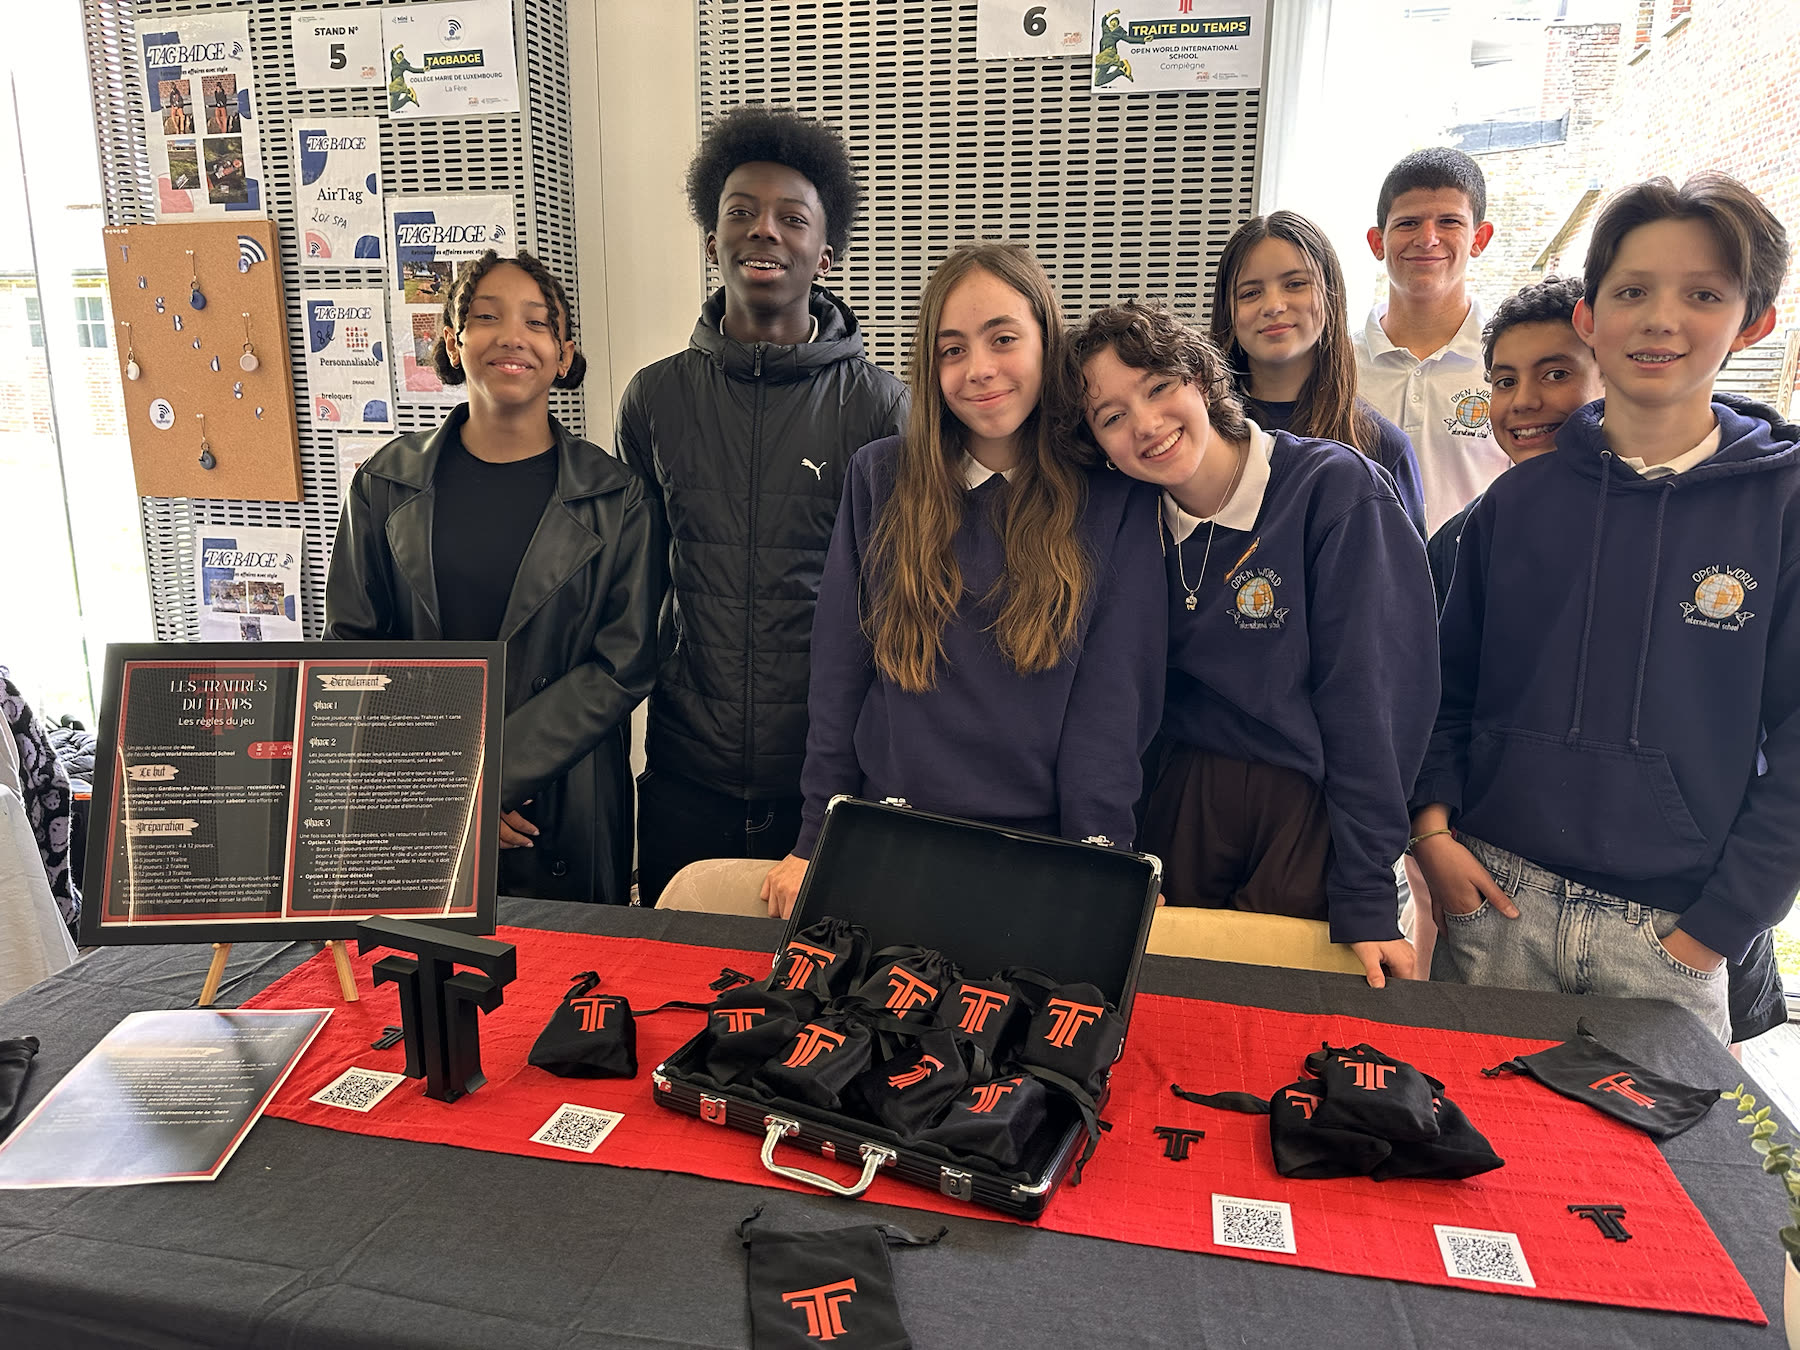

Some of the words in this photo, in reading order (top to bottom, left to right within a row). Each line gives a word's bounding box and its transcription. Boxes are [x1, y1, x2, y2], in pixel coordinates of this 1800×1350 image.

[1023, 6, 1048, 37] 6
[314, 27, 346, 36] STAND
[1132, 23, 1179, 37] TRAITE
[1180, 22, 1200, 35] DU
[1202, 21, 1247, 34] TEMPS
[1181, 44, 1238, 53] INTERNATIONAL
[330, 44, 348, 70] 5
[426, 54, 482, 66] TAGBADGE
[1160, 62, 1206, 72] Compiègne
[410, 74, 434, 84] COLLÈGE
[434, 74, 453, 82] MARIE
[462, 72, 503, 81] LUXEMBOURG
[317, 188, 364, 204] AirTag
[320, 357, 380, 367] Personnalisable
[321, 392, 352, 400] breloques
[1450, 388, 1471, 404] OPEN
[1231, 569, 1254, 590] OPEN
[1257, 568, 1282, 587] WORLD
[1692, 564, 1720, 583] OPEN
[1726, 565, 1758, 590] WORLD
[170, 680, 196, 692] LES
[182, 698, 202, 710] DU
[207, 698, 252, 710] TEMPS
[178, 717, 194, 726] Les
[196, 716, 224, 728] règles
[226, 716, 238, 726] du
[240, 716, 255, 728] jeu
[153, 766, 166, 778] but
